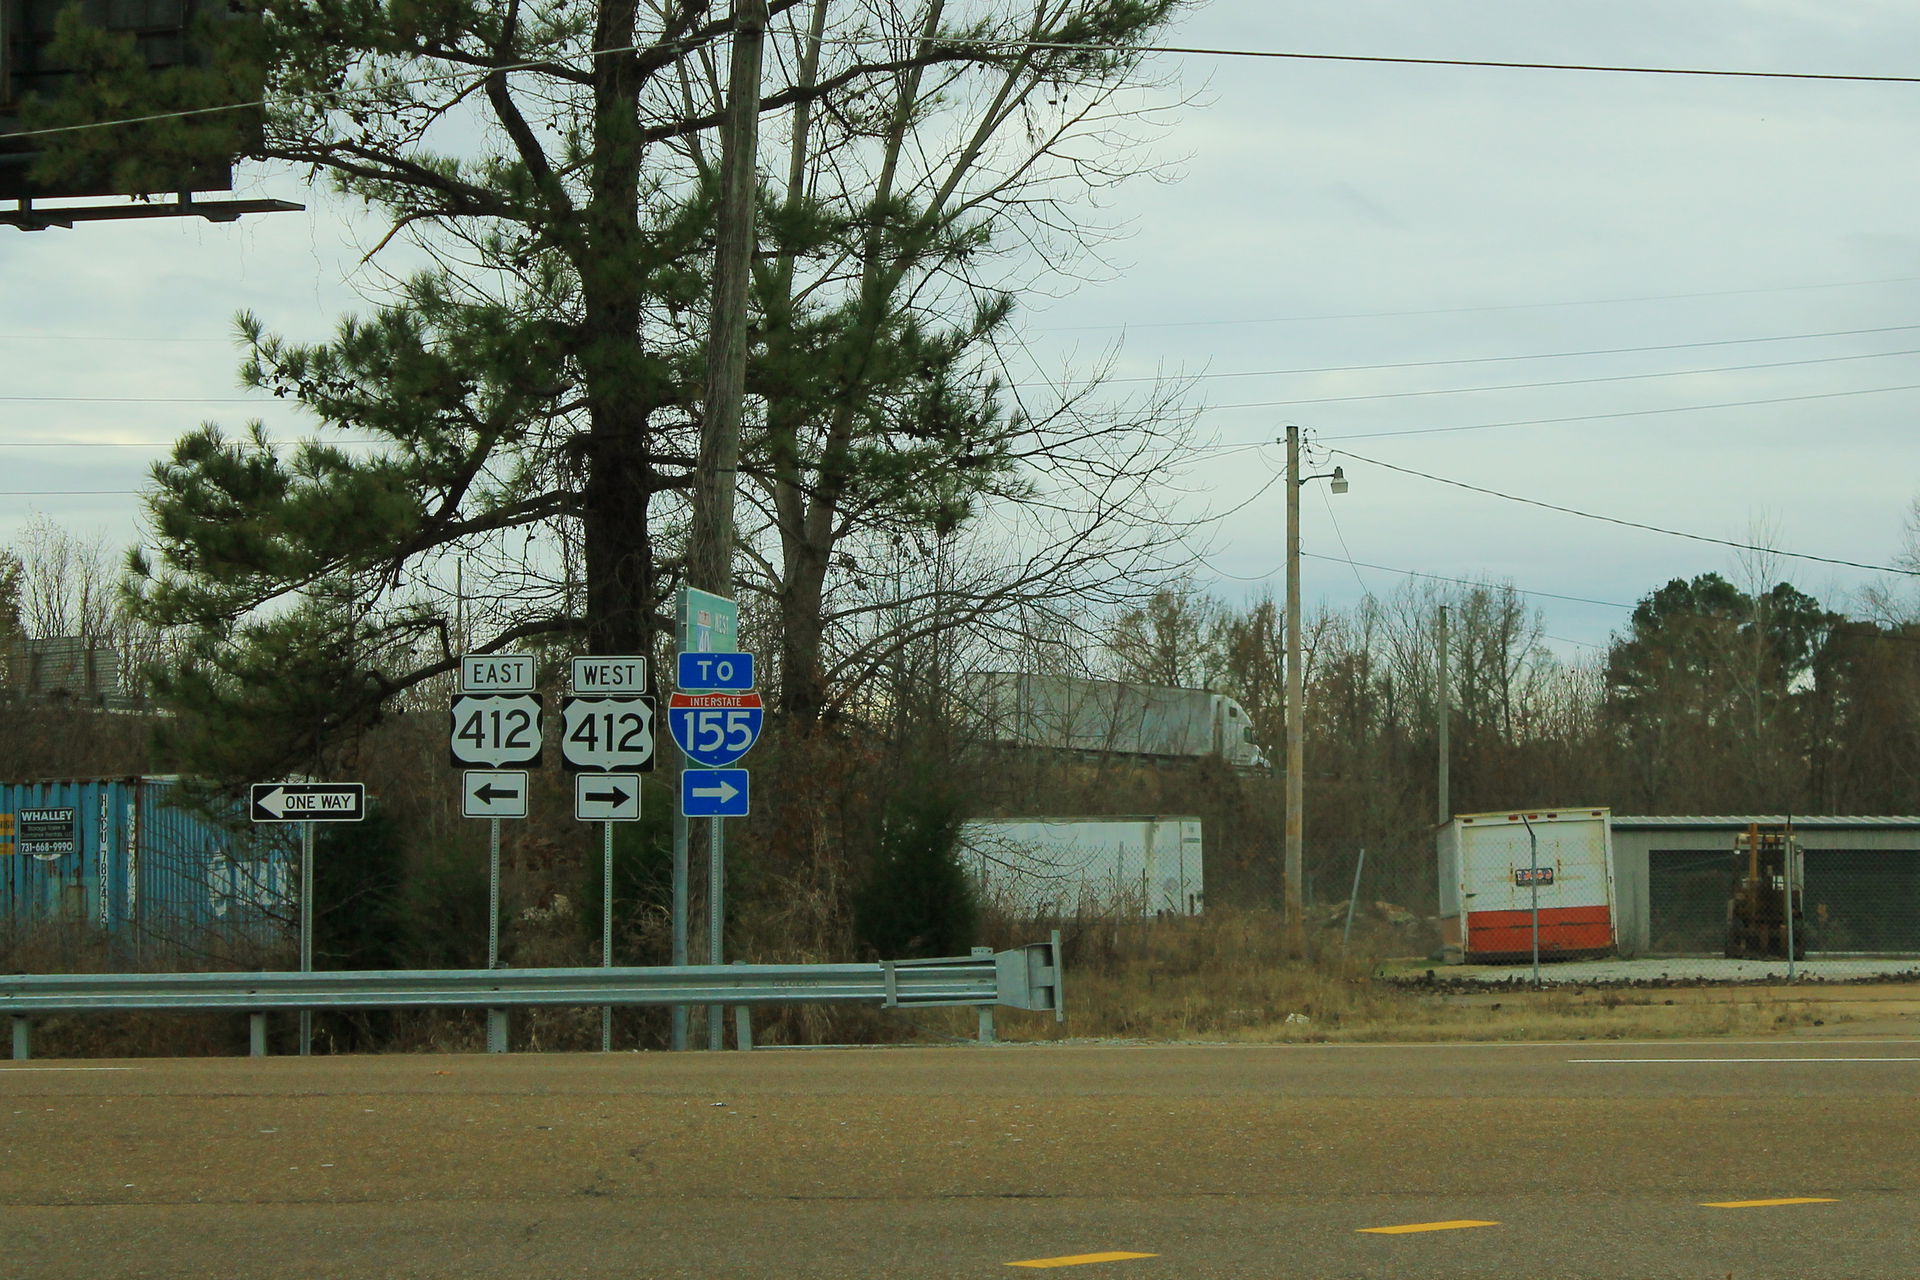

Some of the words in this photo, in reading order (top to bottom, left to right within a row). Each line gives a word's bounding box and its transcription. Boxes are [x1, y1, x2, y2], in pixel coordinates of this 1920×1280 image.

[473, 663, 524, 684] EAST
[583, 665, 636, 685] WEST
[696, 660, 734, 681] TO
[690, 696, 742, 707] INTERSTATE
[457, 709, 531, 749] 412
[570, 712, 644, 752] 412
[683, 711, 752, 752] 155
[285, 795, 316, 810] ONE
[320, 795, 352, 810] WAY
[21, 810, 73, 821] WHALLEY
[21, 841, 73, 852] 731-668-9990
